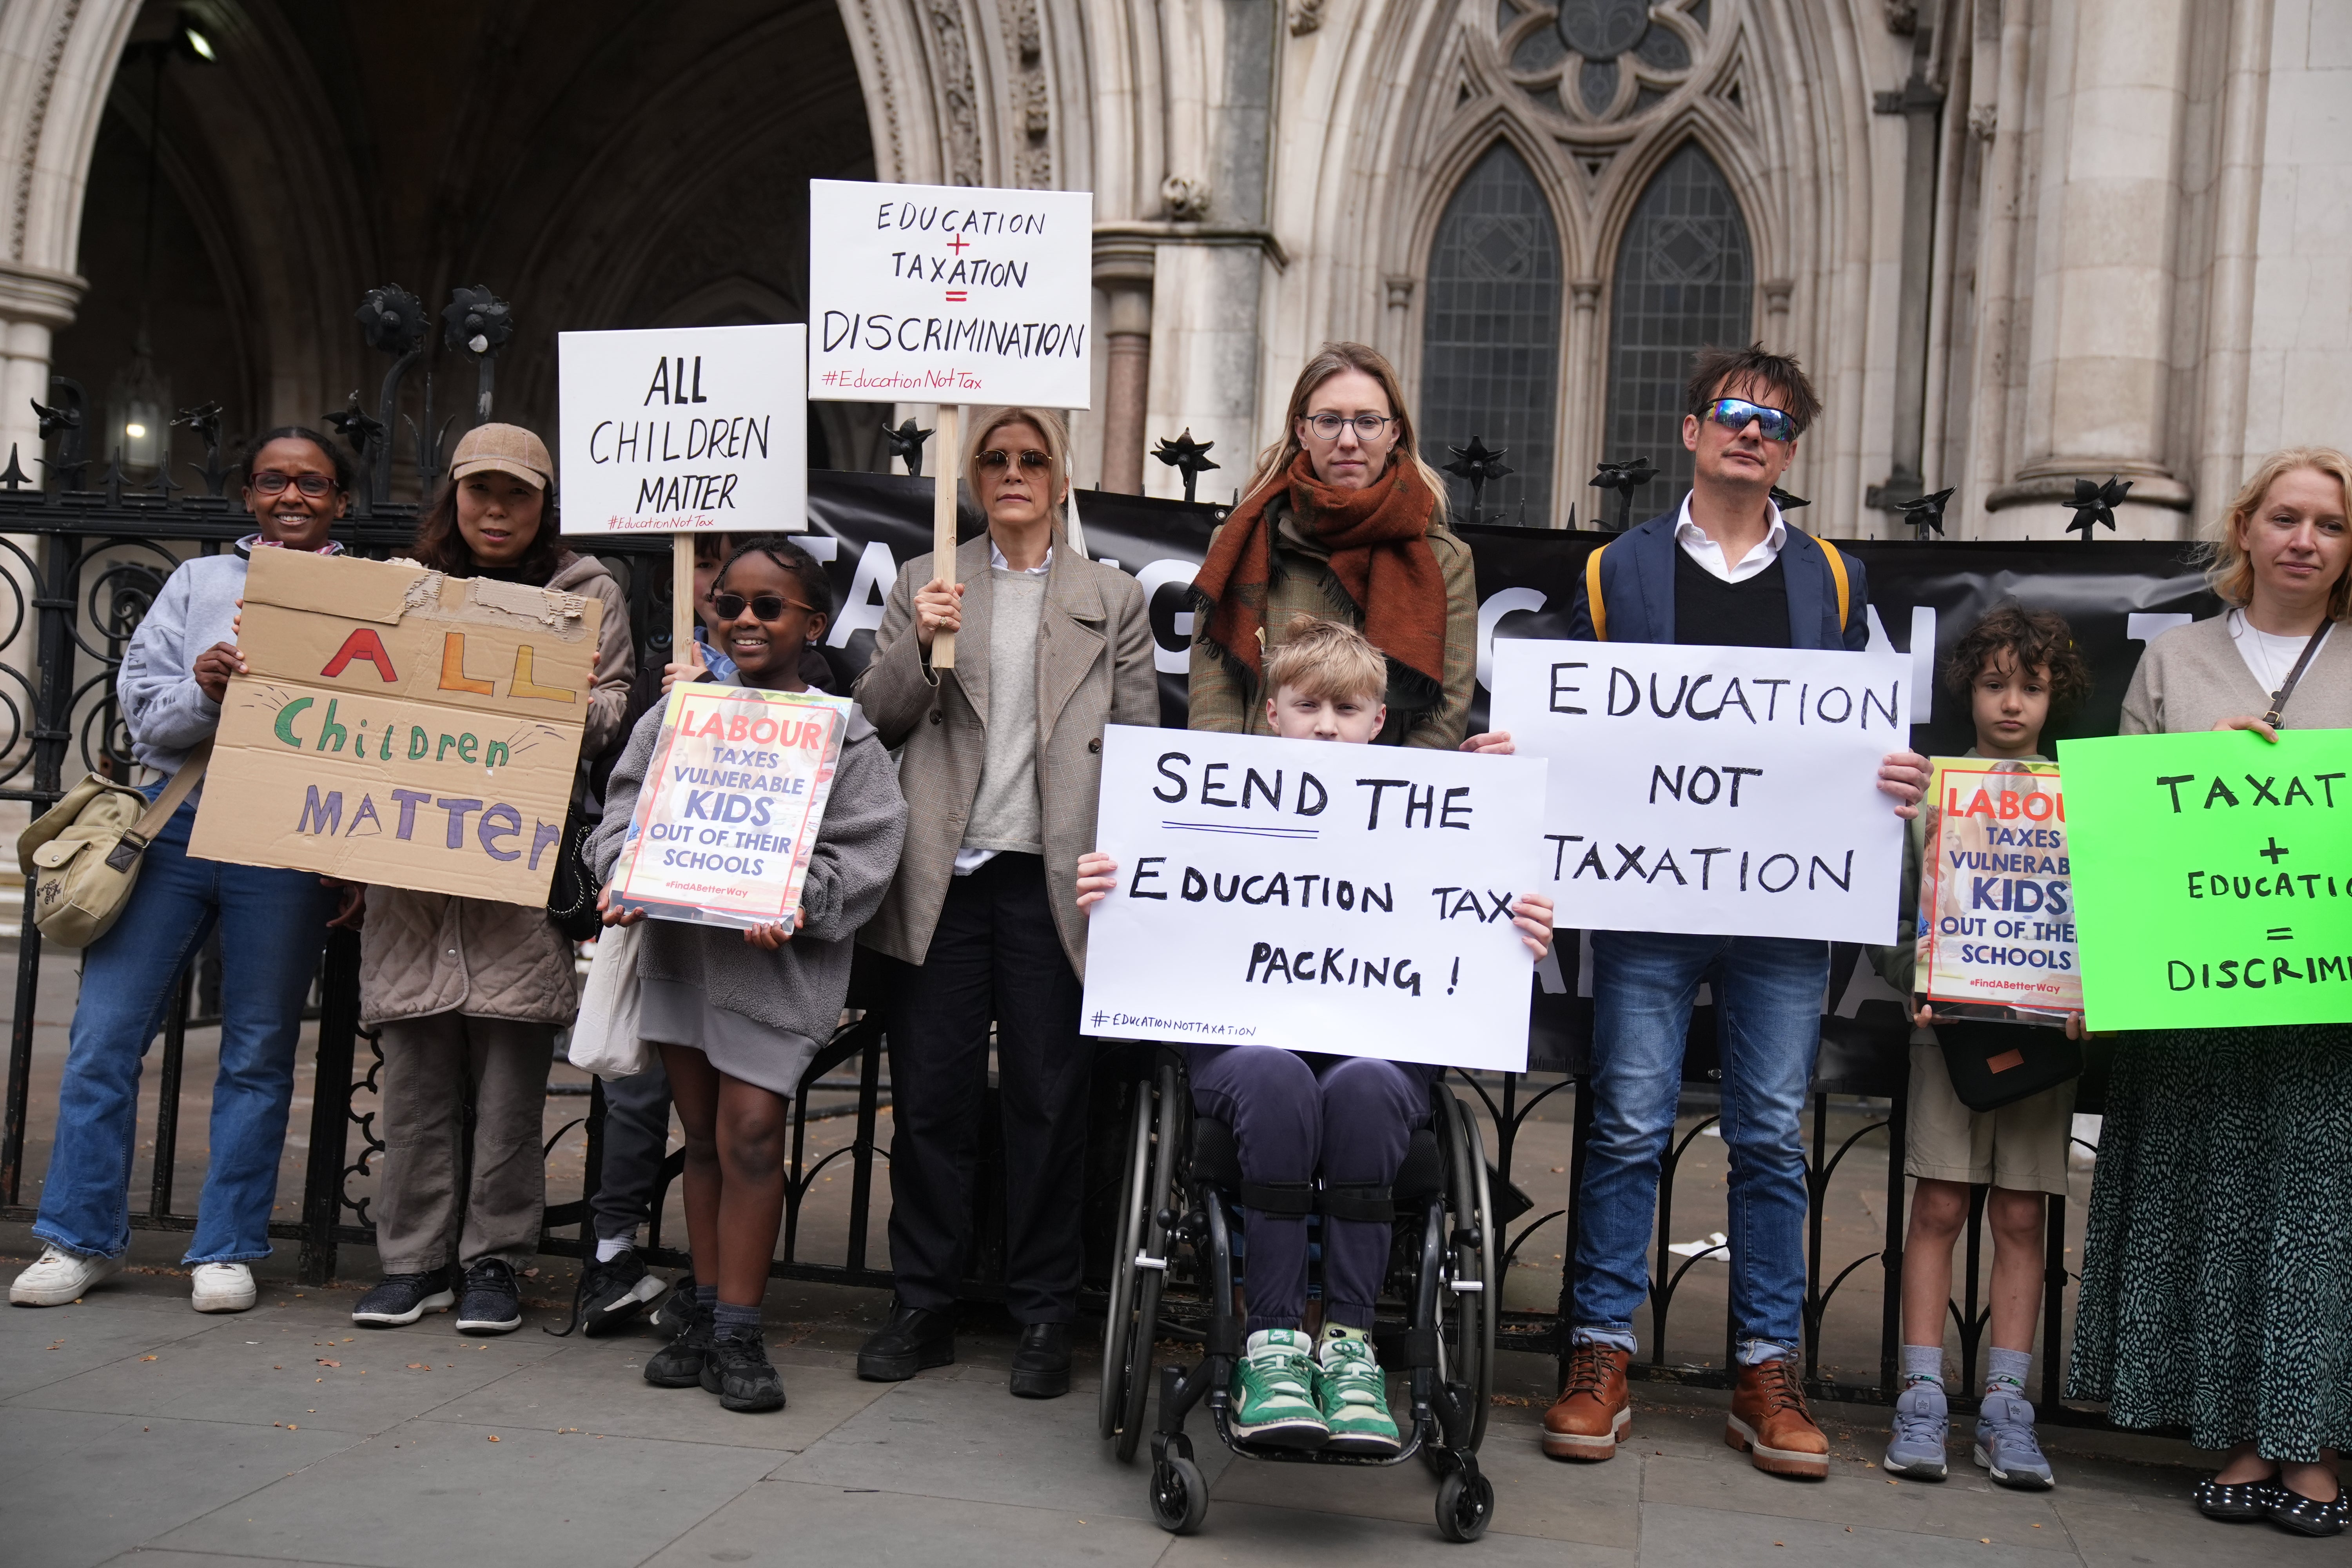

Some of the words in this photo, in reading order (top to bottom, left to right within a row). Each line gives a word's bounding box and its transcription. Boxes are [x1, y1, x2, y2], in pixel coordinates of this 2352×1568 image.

[878, 203, 1045, 234] EDUCATION
[893, 252, 1027, 287] TAXATION
[824, 311, 1084, 359] DISCRIMINATION
[644, 356, 706, 406] ALL
[822, 368, 982, 390] #EducationNotTax
[591, 415, 769, 463] CHILDREN
[636, 474, 737, 514] MATTER
[608, 515, 713, 529] #EducationNotTax
[320, 628, 576, 704] ALL
[1550, 663, 1898, 730] EDUCATION
[681, 710, 822, 750] LABOUR
[713, 747, 779, 768] TAXES
[674, 766, 804, 795] VULNERABLE
[1153, 752, 1327, 816] SEND
[1356, 779, 1472, 830] THE
[1650, 765, 1763, 807] NOT
[2157, 773, 2345, 813] TAXAT
[684, 789, 774, 827] KIDS
[650, 823, 694, 840] OUT
[699, 828, 729, 846] OF
[735, 832, 791, 854] THEIR
[1986, 827, 2061, 849] TAXES
[663, 849, 764, 876] SCHOOLS
[1544, 835, 1853, 893] TAXATION
[666, 881, 748, 898] #FindABetterWay
[1130, 857, 1392, 913] EDUCATION
[1432, 887, 1515, 923] TAX
[1972, 877, 2067, 916] KIDS
[2189, 871, 2352, 898] EDUCATI
[1940, 917, 1989, 936] OUT
[1994, 920, 2026, 940] OF
[2033, 922, 2078, 942] THE
[1246, 942, 1420, 996] PACKING
[1961, 944, 2072, 969] SCHOOLS
[1969, 978, 2060, 995] #FindABetterWay
